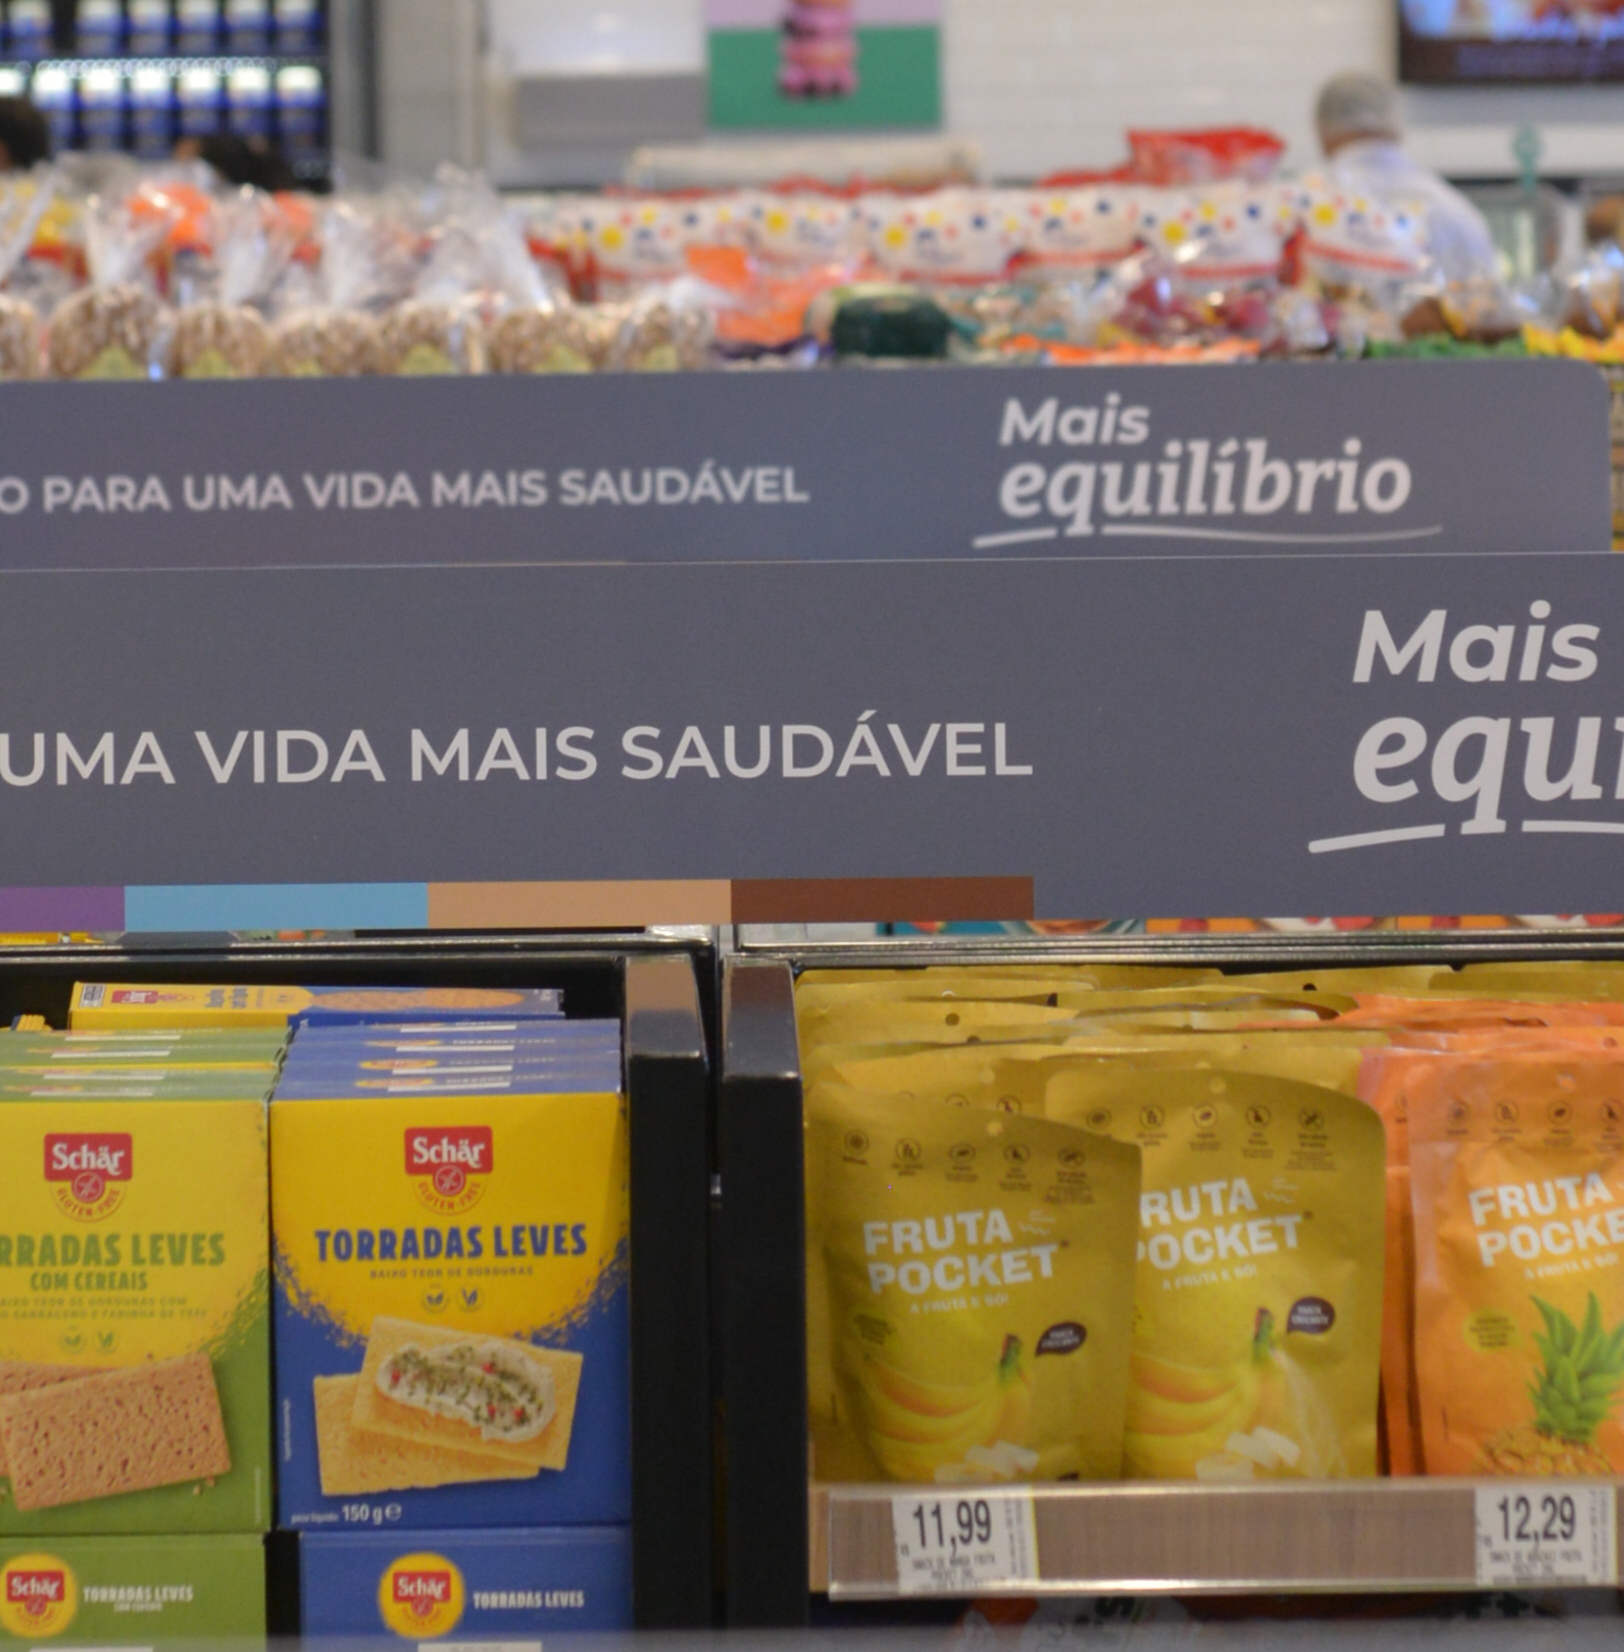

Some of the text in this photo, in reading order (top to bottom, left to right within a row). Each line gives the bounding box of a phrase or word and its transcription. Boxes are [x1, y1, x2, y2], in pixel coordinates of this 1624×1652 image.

[998, 392, 1149, 447] Mais
[43, 476, 171, 512] PARA
[183, 472, 294, 511] UMA
[303, 471, 419, 508] VIDA
[432, 470, 548, 506] MAIS
[559, 459, 810, 506] SAUDÁVEL
[998, 437, 1413, 537] equilíbrio
[1352, 600, 1601, 683] Mais
[195, 729, 386, 784] VIDA
[411, 726, 597, 781] MAIS
[622, 710, 1033, 780] SAUDÁVEL
[51, 1141, 126, 1177] Schär
[412, 1135, 486, 1169] Schär
[1139, 1176, 1259, 1229] RUTA
[1468, 1171, 1616, 1227] FRUTA
[131, 1230, 227, 1267] LEVES
[315, 1223, 589, 1263] TORRADAS LEVES
[863, 1208, 1014, 1256] FRUTA
[31, 1270, 149, 1291] COM CEREAIS
[867, 1243, 1060, 1295] POCKET
[342, 1503, 369, 1522] 150
[912, 1499, 992, 1557] 11,99
[1498, 1494, 1576, 1551] 12,29
[12, 1575, 61, 1599] Schär
[83, 1584, 194, 1603] TORRADAS LEVES
[397, 1575, 448, 1600] Schär
[473, 1590, 585, 1610] TORRADAS LEVES
